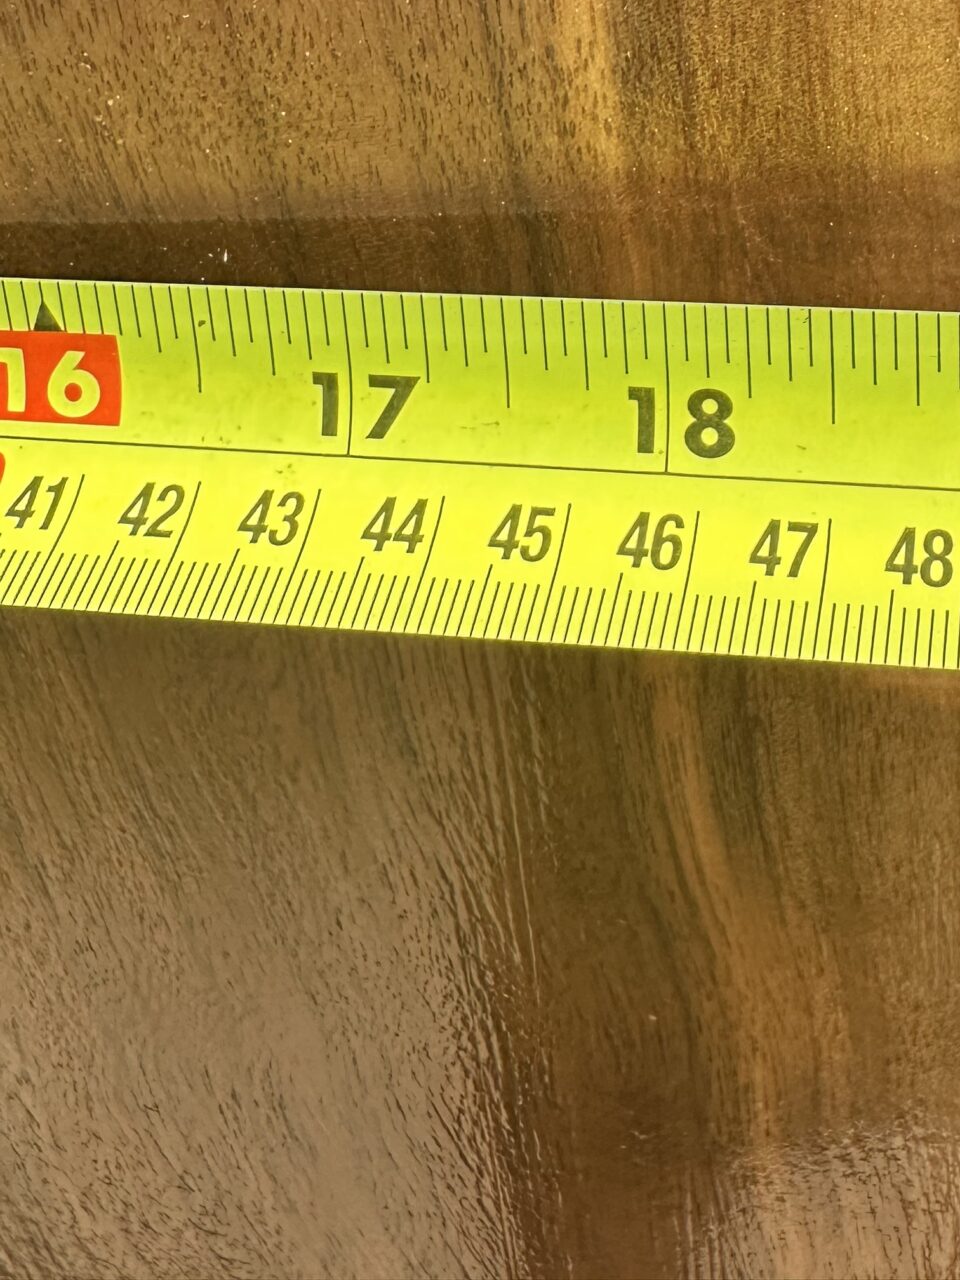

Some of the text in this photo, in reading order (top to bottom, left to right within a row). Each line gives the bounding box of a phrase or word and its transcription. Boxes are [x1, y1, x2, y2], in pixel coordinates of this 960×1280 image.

[0, 348, 102, 419] 16
[311, 370, 422, 440] 17
[627, 385, 736, 459] 18
[5, 474, 70, 530] 41
[118, 483, 186, 539] 42
[236, 489, 305, 547] 43
[360, 496, 430, 554] 44
[487, 503, 557, 563] 45
[616, 510, 686, 571] 46
[749, 518, 820, 579] 47
[884, 525, 955, 588] 48
